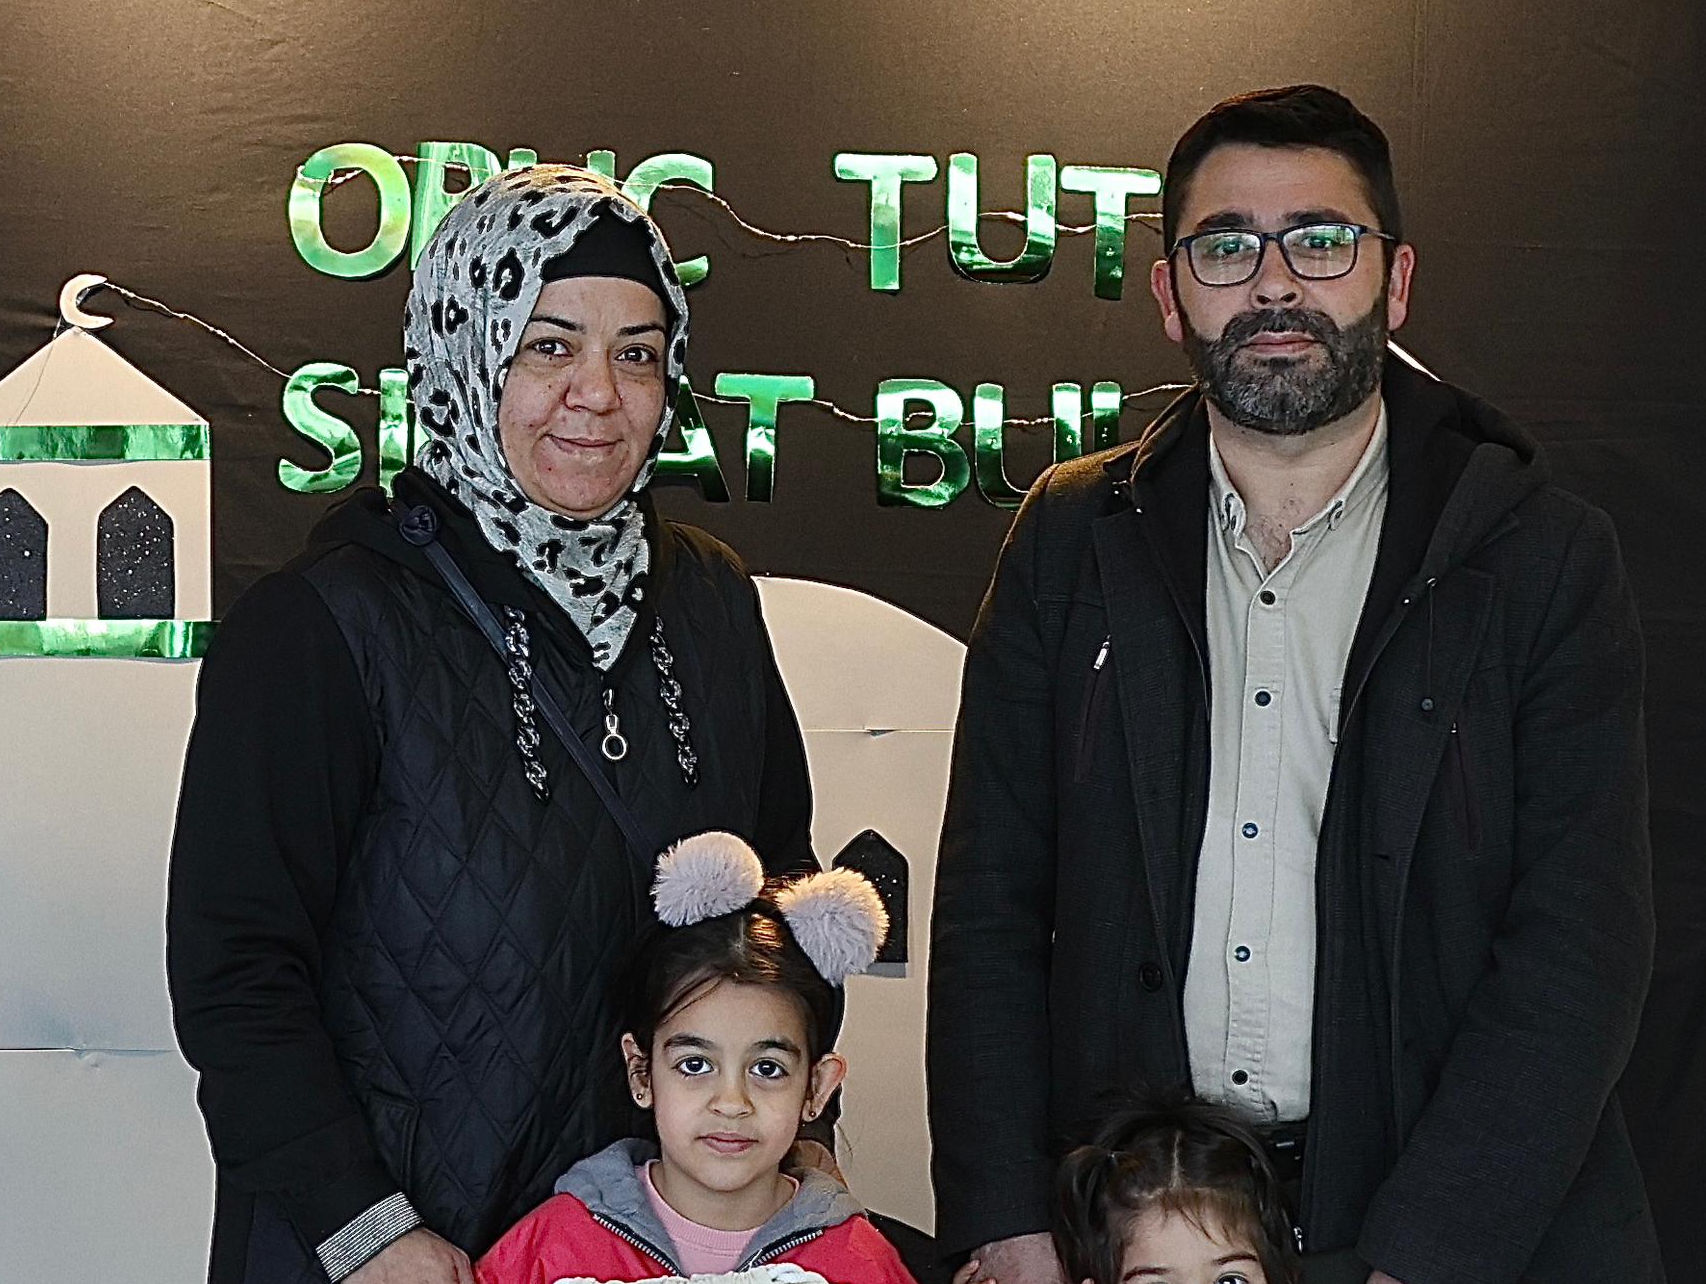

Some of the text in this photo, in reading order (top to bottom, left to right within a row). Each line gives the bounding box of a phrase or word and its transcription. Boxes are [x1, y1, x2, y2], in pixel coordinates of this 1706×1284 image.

[288, 140, 1163, 303] OR TUT
[279, 361, 817, 505] SIAT
